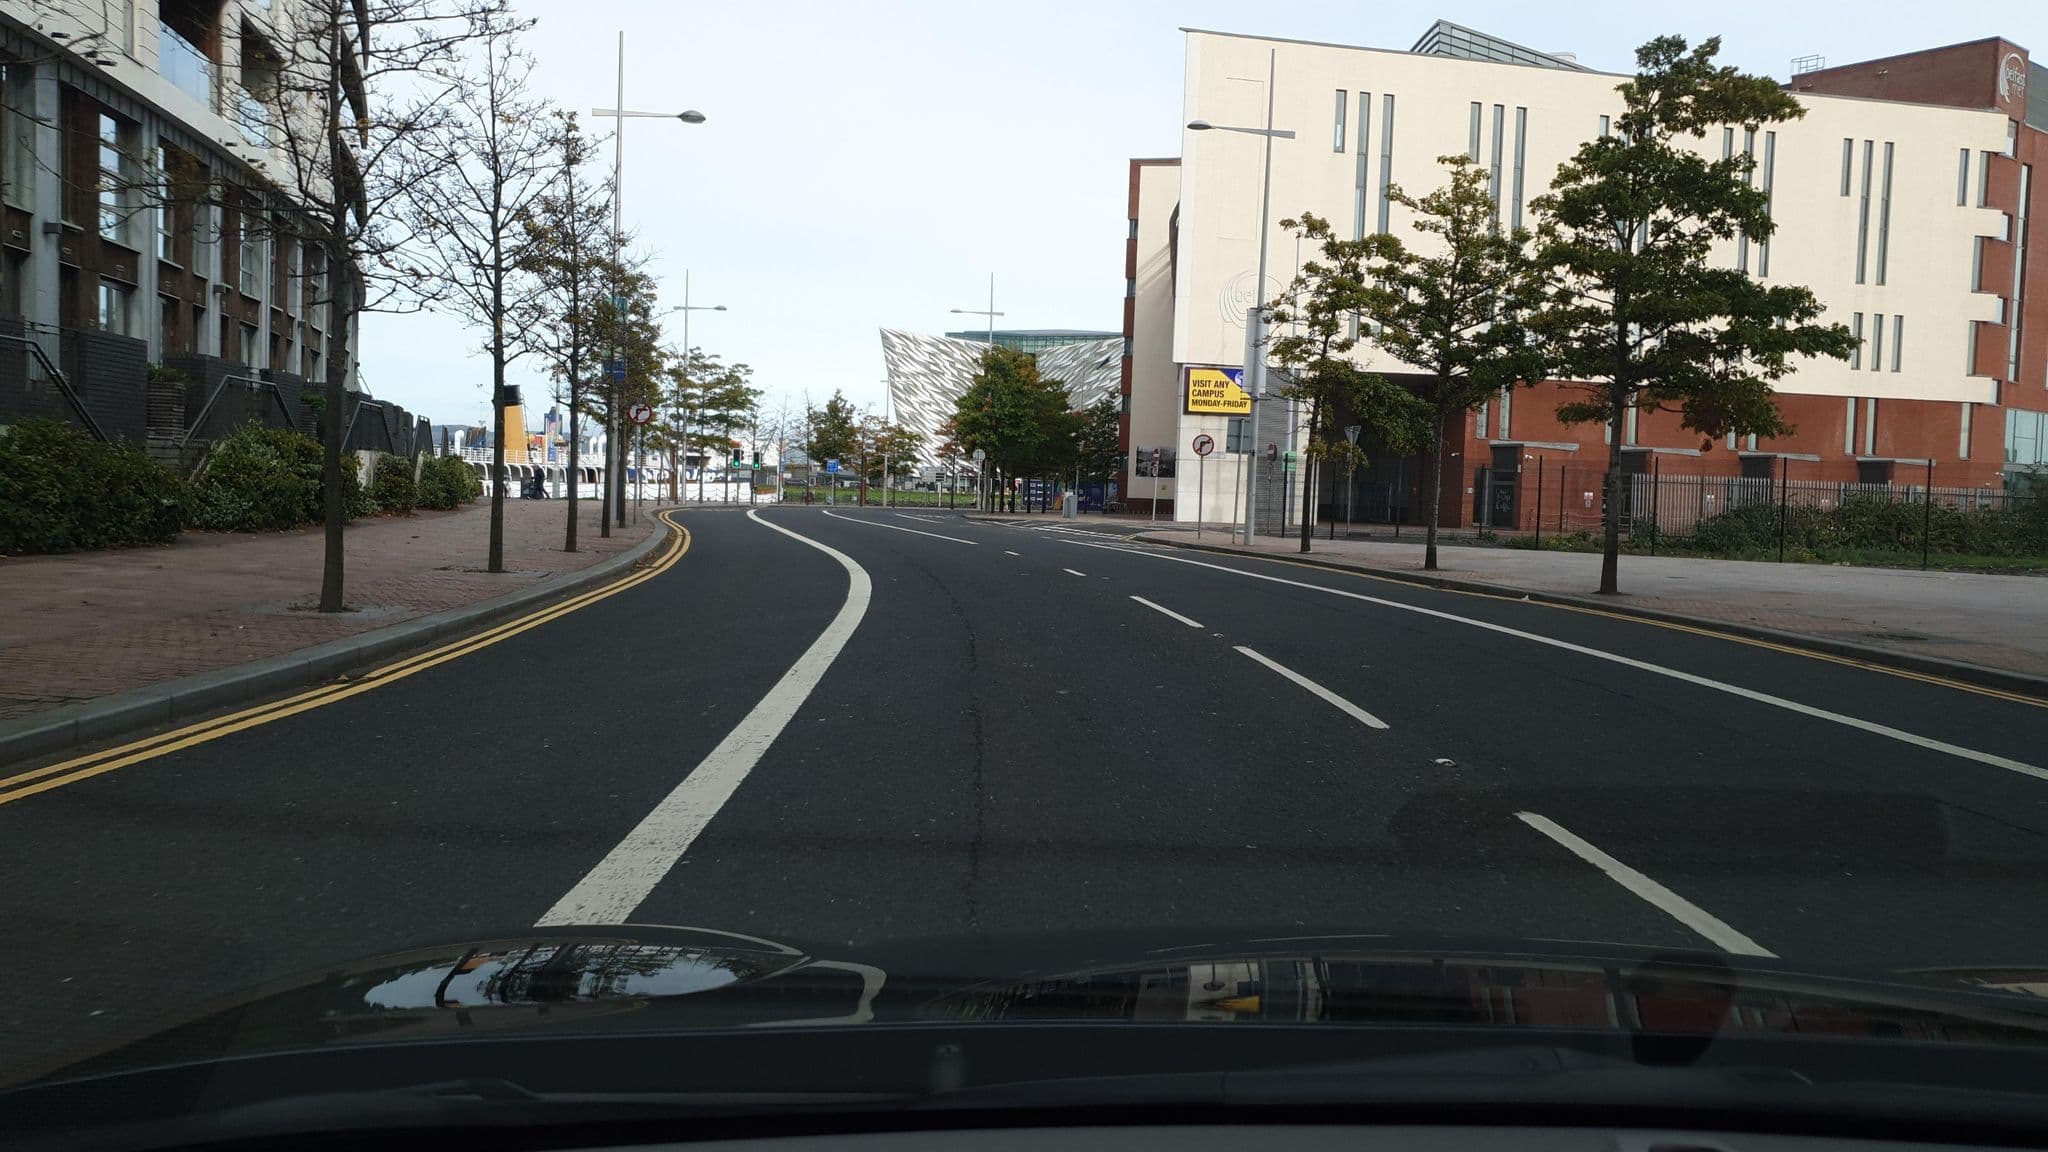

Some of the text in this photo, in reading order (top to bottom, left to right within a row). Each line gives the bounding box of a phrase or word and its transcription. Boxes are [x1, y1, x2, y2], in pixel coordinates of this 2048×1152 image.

[1192, 380, 1230, 389] VISIT ANY
[1191, 389, 1225, 398] CAMPUS
[1191, 399, 1248, 408] MONDAY-FRIDAY
